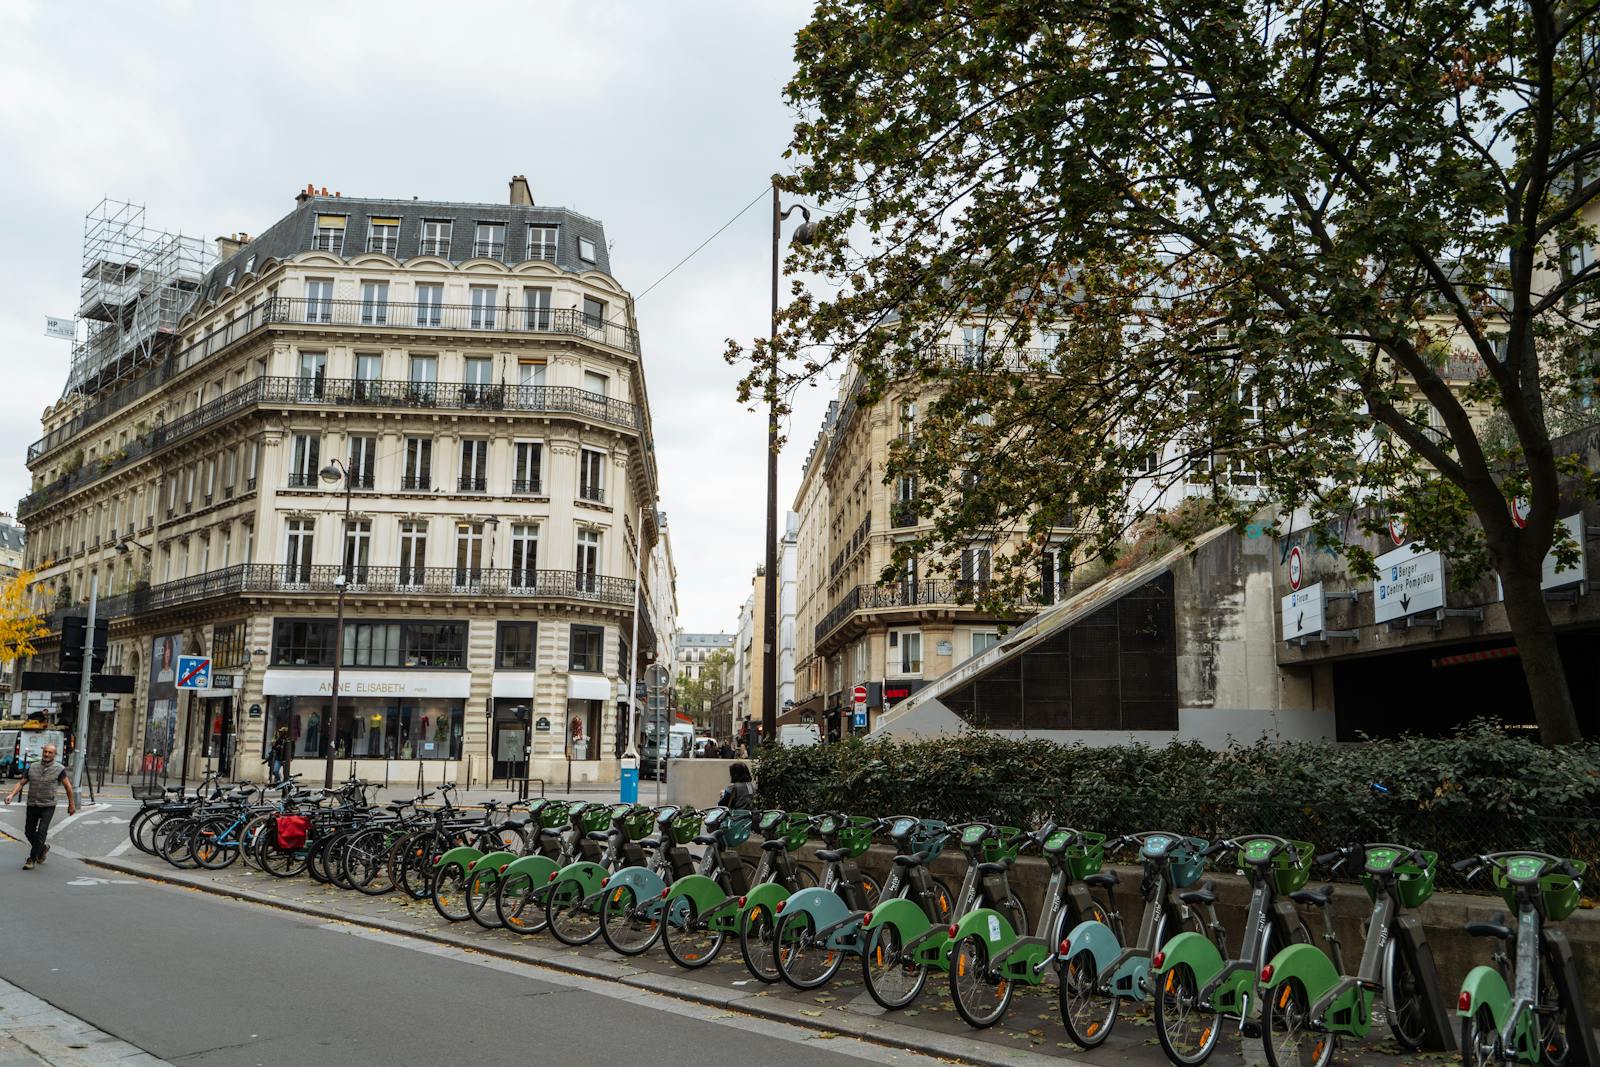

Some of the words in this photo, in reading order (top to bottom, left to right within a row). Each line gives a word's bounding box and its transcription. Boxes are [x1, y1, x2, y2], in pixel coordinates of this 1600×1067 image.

[1399, 564, 1417, 577] Berger
[1387, 583, 1404, 596] Centre
[1405, 572, 1434, 589] Pompidou
[357, 683, 406, 692] ELISABETH
